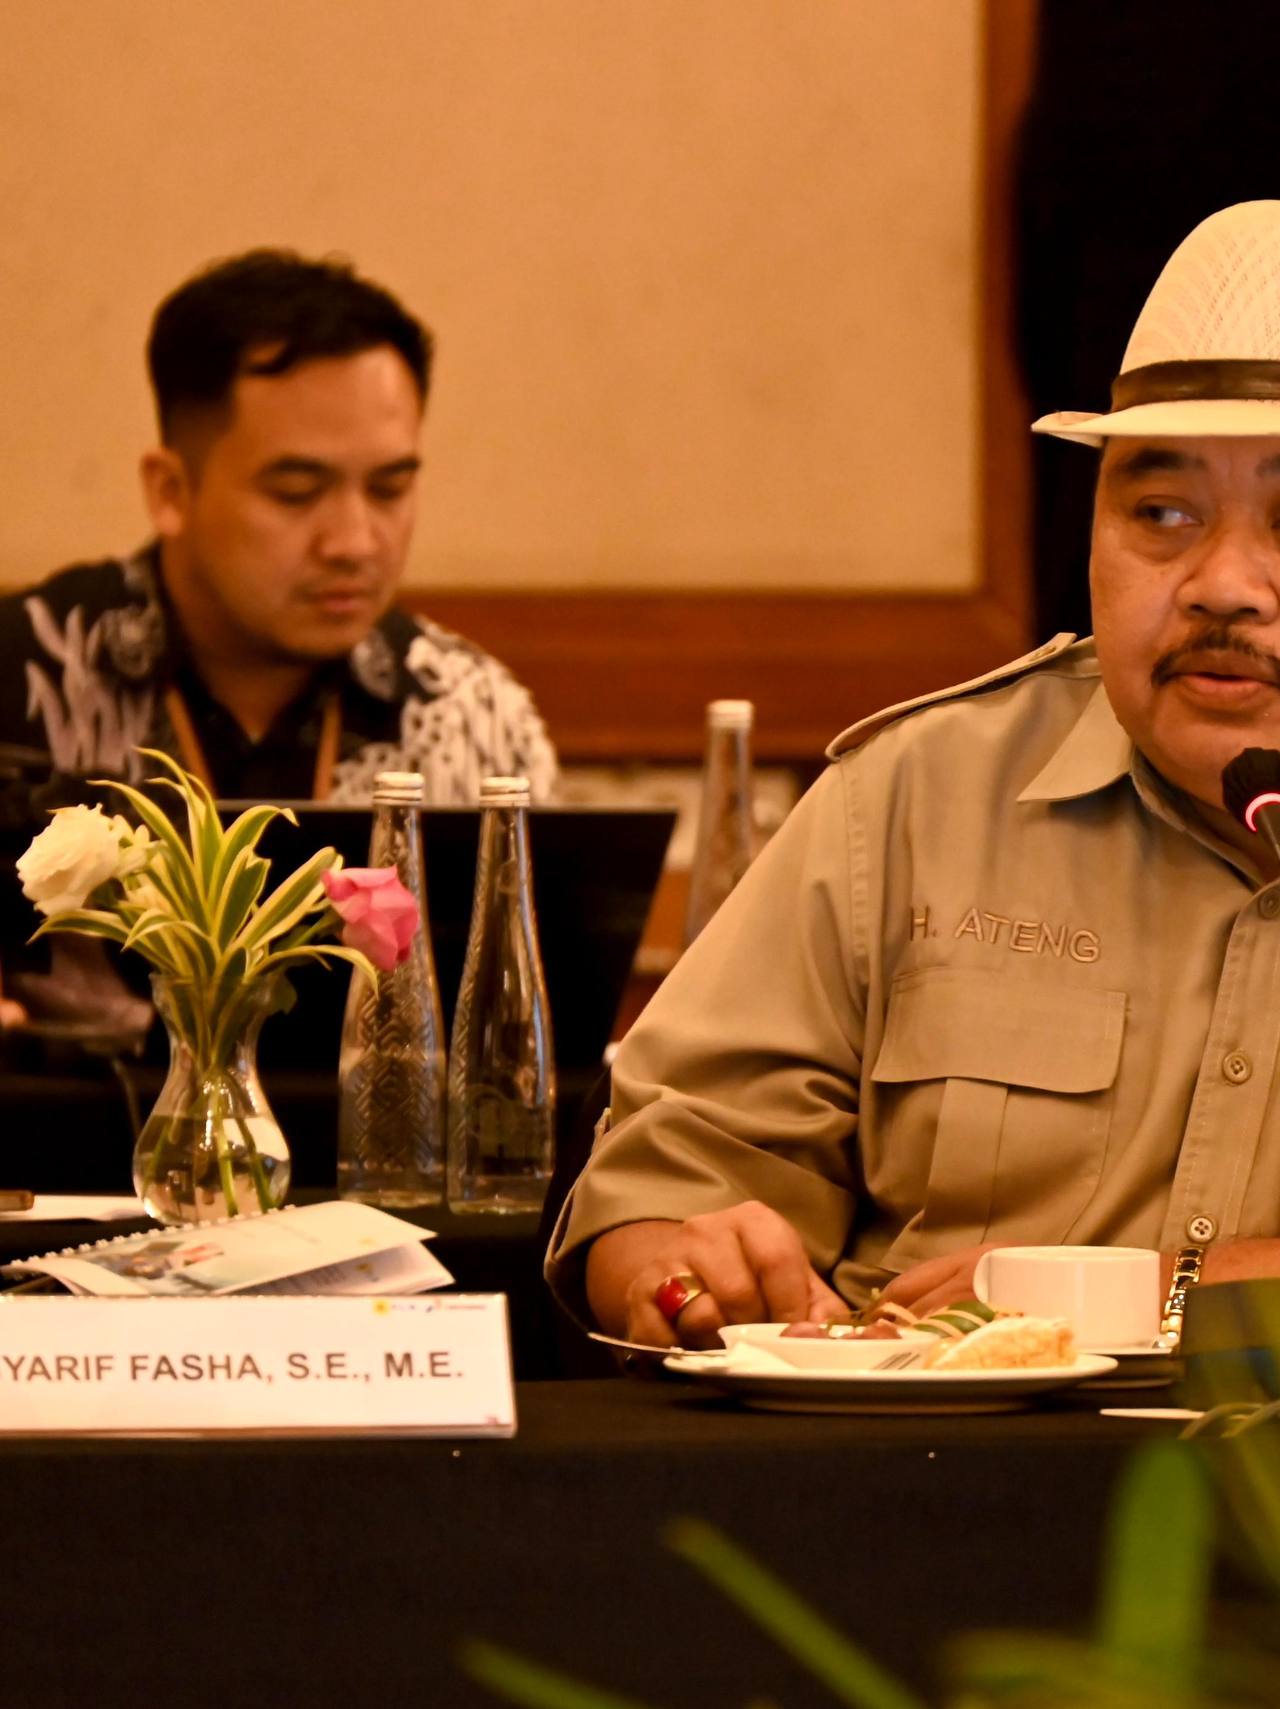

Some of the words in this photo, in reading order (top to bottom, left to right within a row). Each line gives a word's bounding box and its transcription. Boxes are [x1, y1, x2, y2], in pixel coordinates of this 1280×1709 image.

[910, 905, 937, 941] H.
[954, 907, 1100, 963] ATENG
[0, 1355, 114, 1382] YARIF
[130, 1353, 273, 1384] FASHA,
[287, 1352, 370, 1382] S.E.,
[384, 1351, 463, 1379] M.E.
